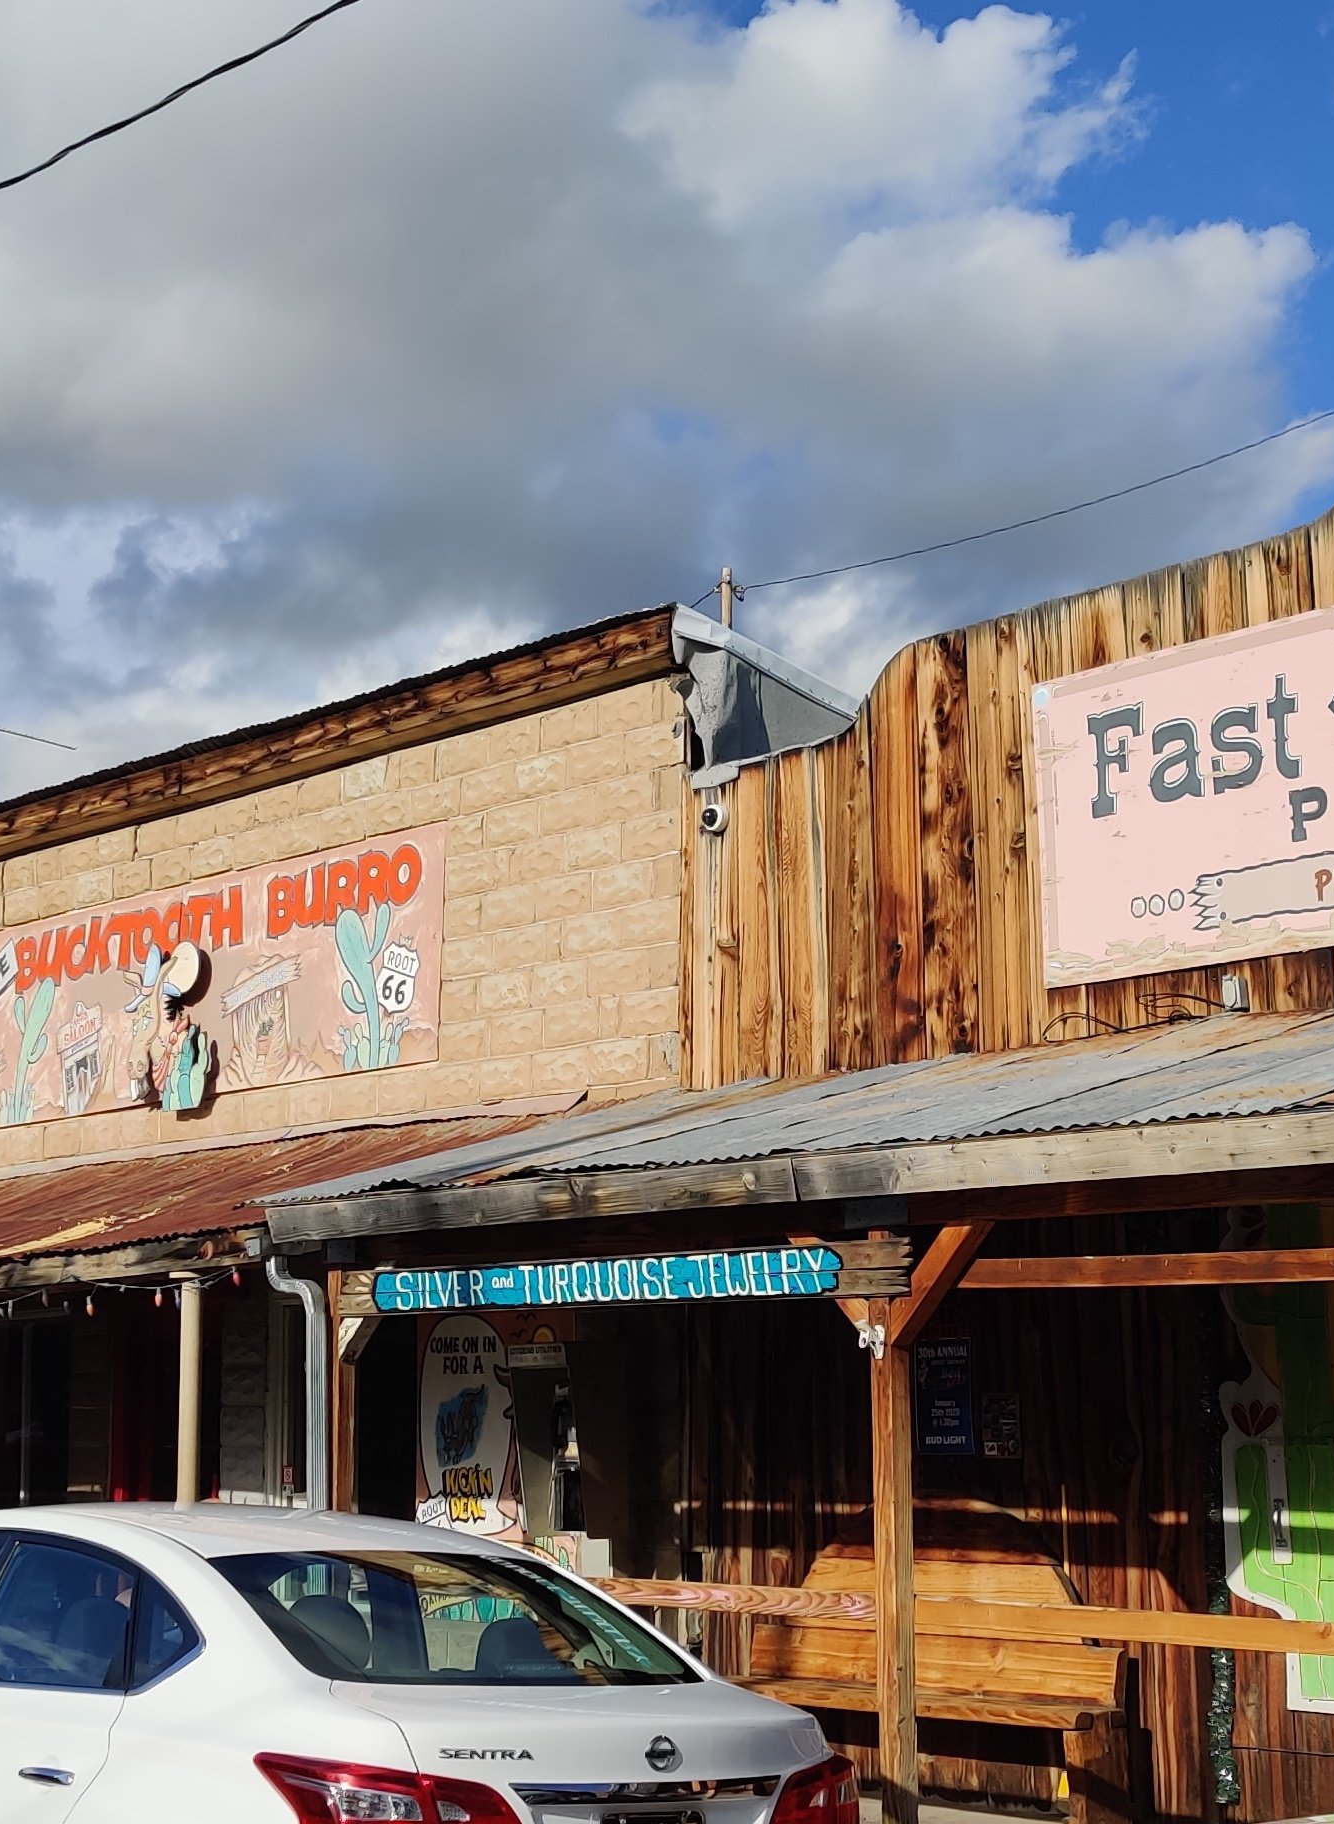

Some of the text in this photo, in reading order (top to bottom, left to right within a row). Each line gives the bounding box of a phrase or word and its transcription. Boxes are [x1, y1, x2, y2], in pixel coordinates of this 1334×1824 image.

[1087, 672, 1305, 819] Fast
[14, 884, 245, 995] BUCKTOOTH
[266, 843, 423, 940] BURRO
[387, 950, 416, 977] ROOT
[381, 974, 408, 1006] 66
[395, 1247, 827, 1312] SILVER and TURQUOISE JEWELRY
[429, 1335, 497, 1354] COME ON IN
[917, 1344, 968, 1360] 30th ANNUAL
[442, 1355, 485, 1375] FOR A
[925, 1435, 966, 1445] BUD LIGHT
[449, 1495, 487, 1524] DEAL
[438, 1747, 535, 1761] SENTRA
